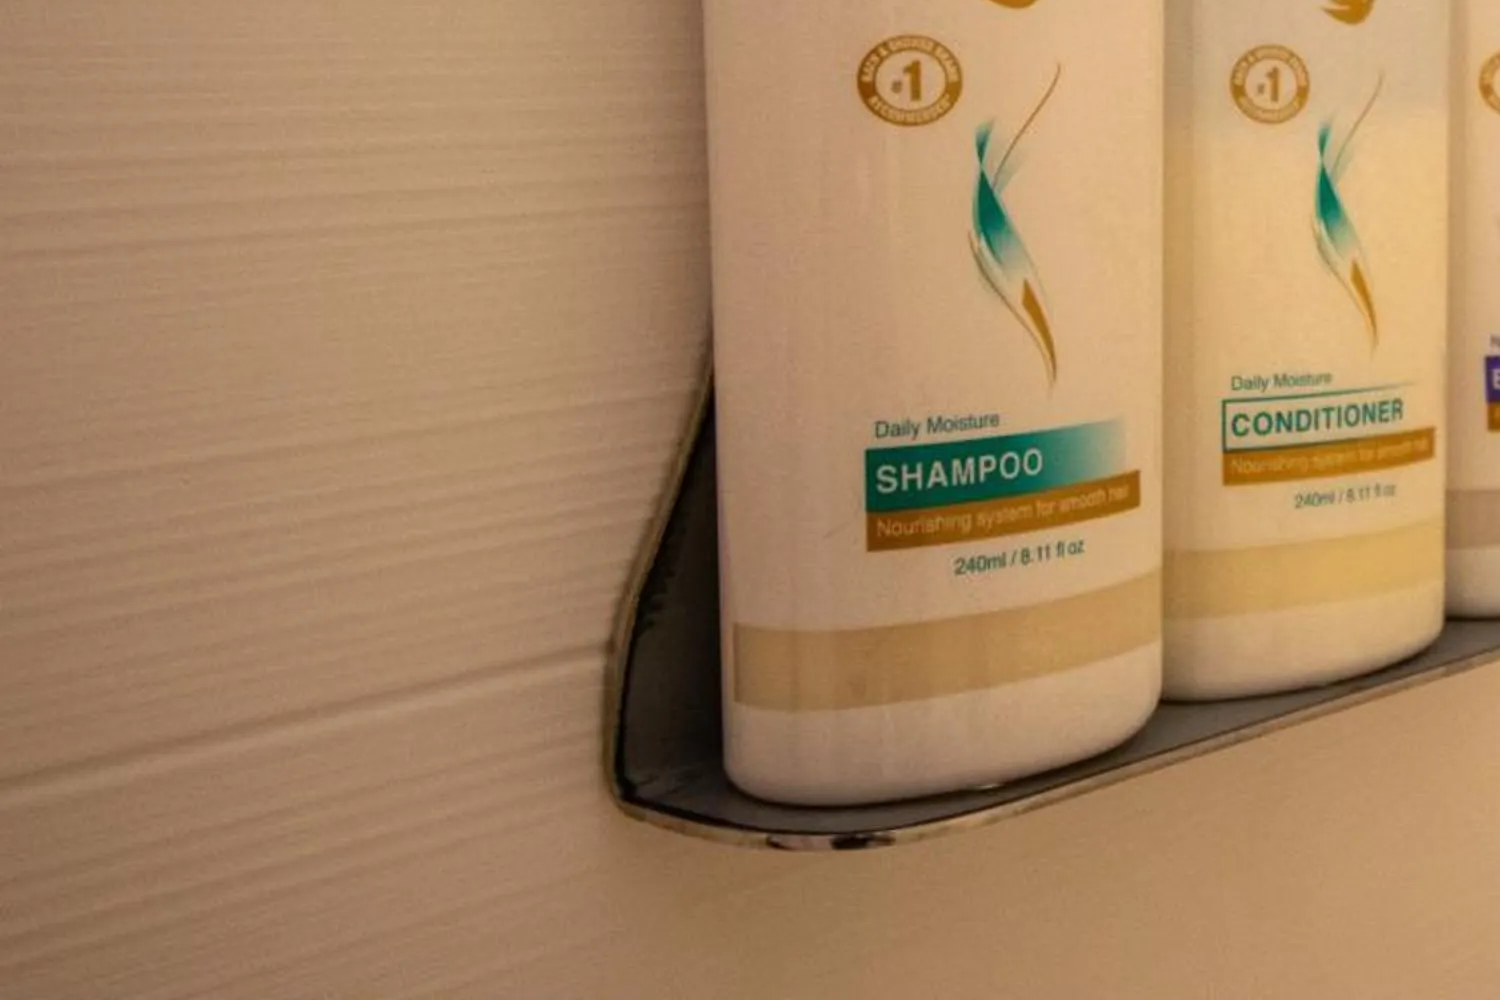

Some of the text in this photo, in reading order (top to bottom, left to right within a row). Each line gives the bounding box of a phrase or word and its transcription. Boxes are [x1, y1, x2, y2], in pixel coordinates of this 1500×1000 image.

[1231, 371, 1333, 393] Daily Moisture
[875, 413, 1000, 440] Daily Moisture
[1231, 398, 1404, 437] CONDITIONER
[876, 448, 1043, 493] SHAMPOO
[1294, 490, 1336, 510] 240ml
[877, 512, 972, 538] Nourishing
[976, 503, 1034, 529] system
[1036, 498, 1054, 517] for
[955, 551, 1006, 576] 240ml
[1020, 544, 1051, 566] 8.11
